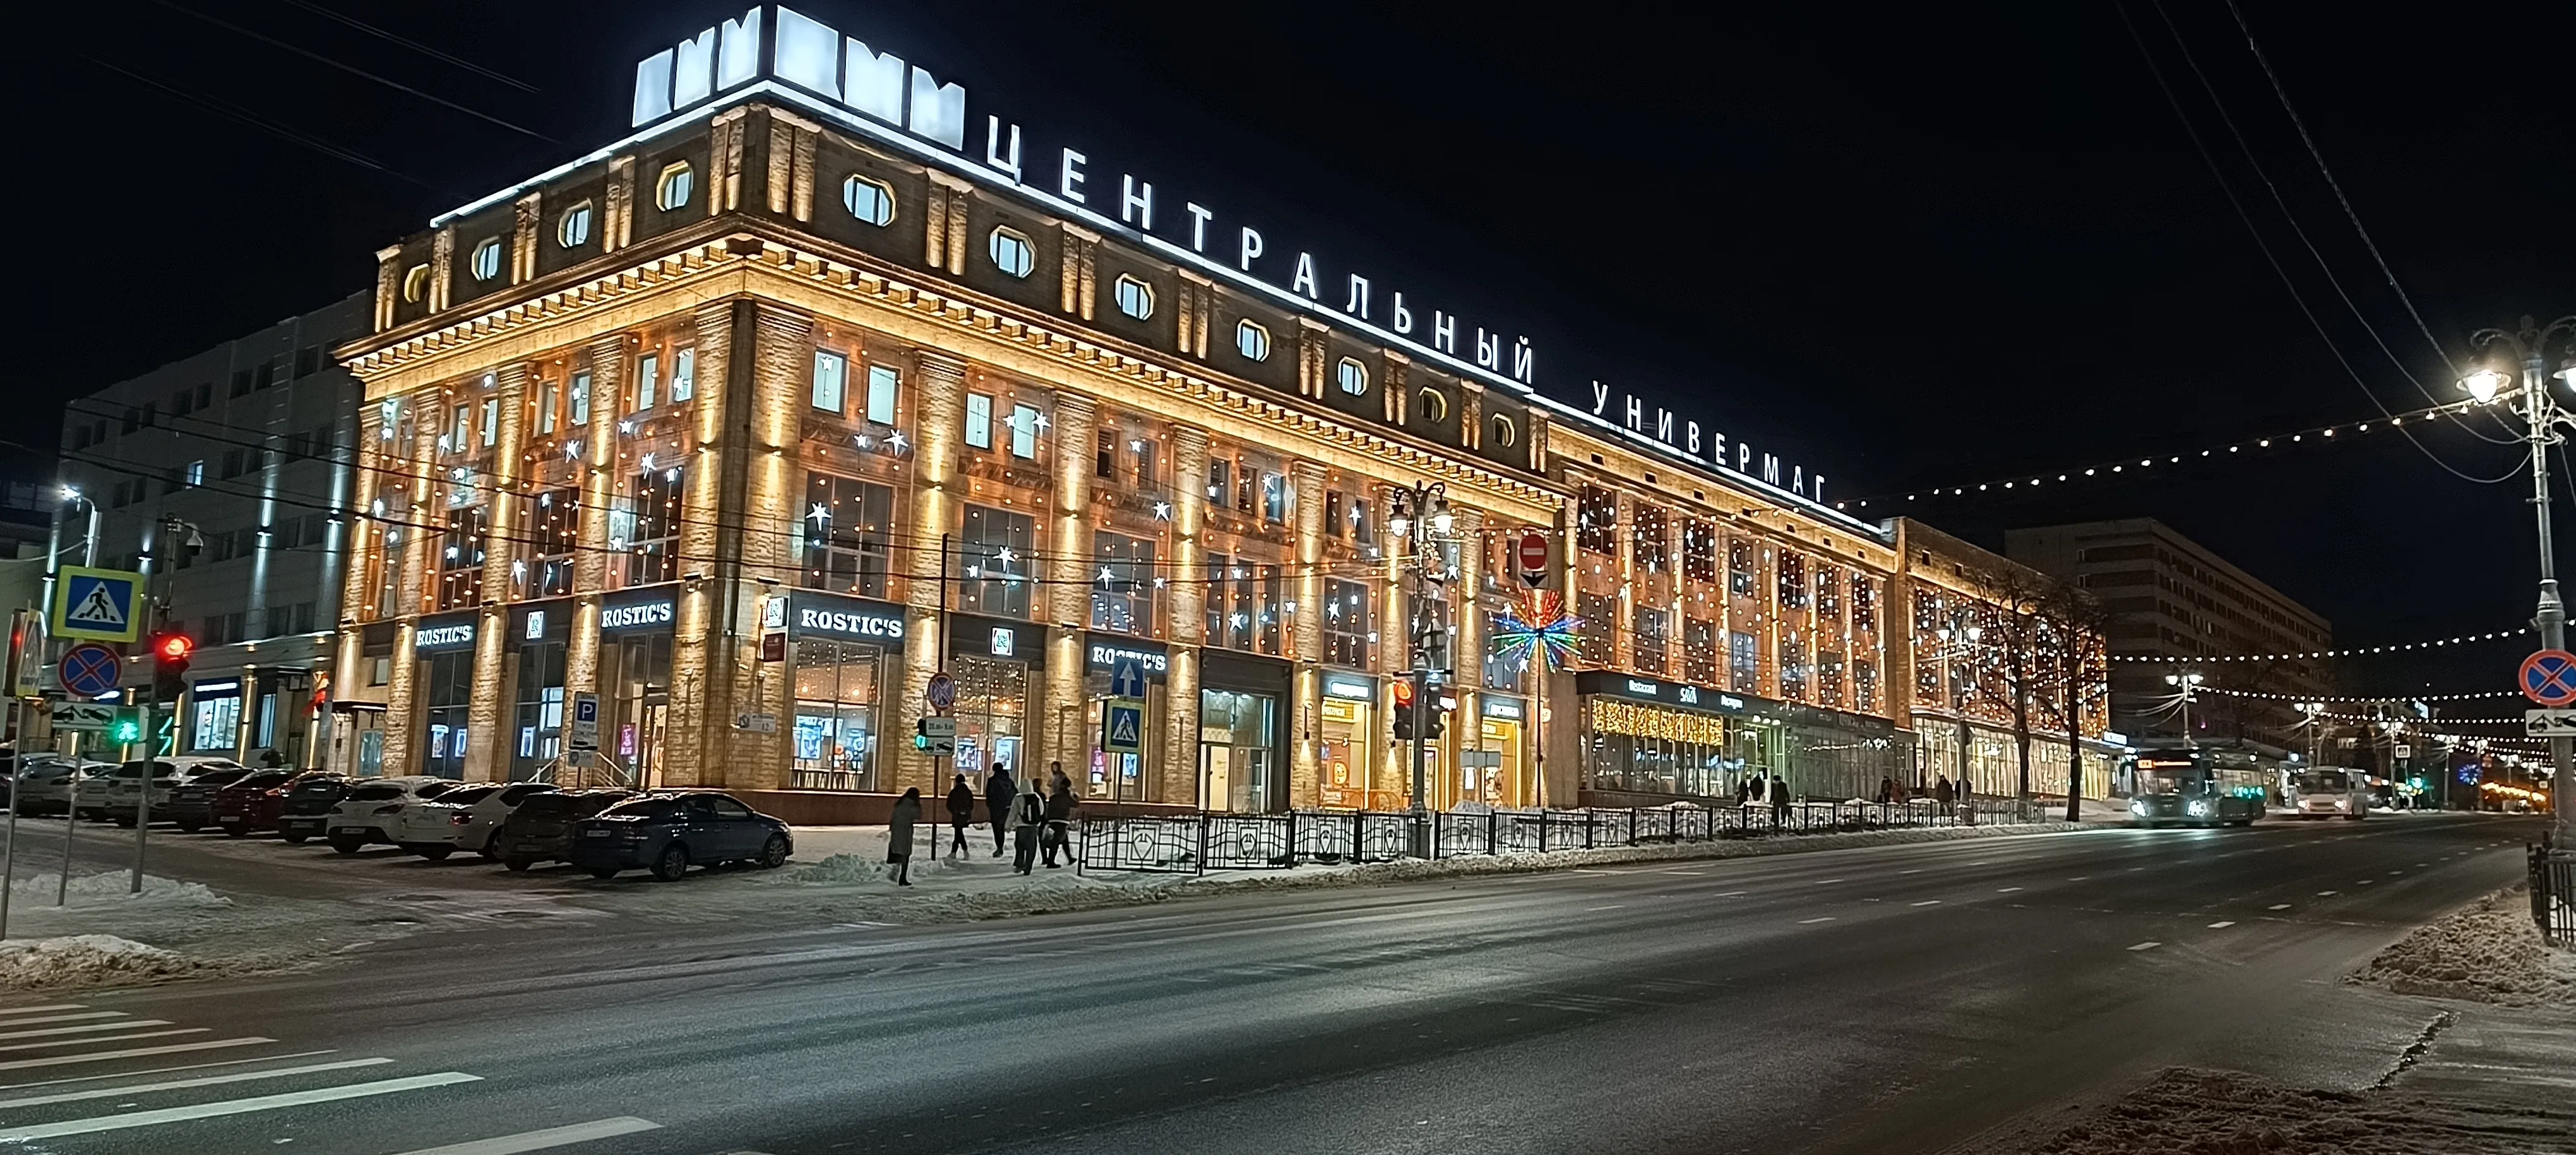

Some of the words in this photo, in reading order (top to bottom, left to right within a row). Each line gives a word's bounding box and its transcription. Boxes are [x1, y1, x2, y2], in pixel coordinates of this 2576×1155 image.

[987, 115, 1533, 384] ЦЕНТРАЛЬНЫЙ
[1592, 380, 1827, 504] УНИВЕРМАГ
[599, 602, 672, 629] ROSTIC'S
[801, 608, 903, 637] ROSTIC'S
[415, 625, 473, 646] ROSTIC'S
